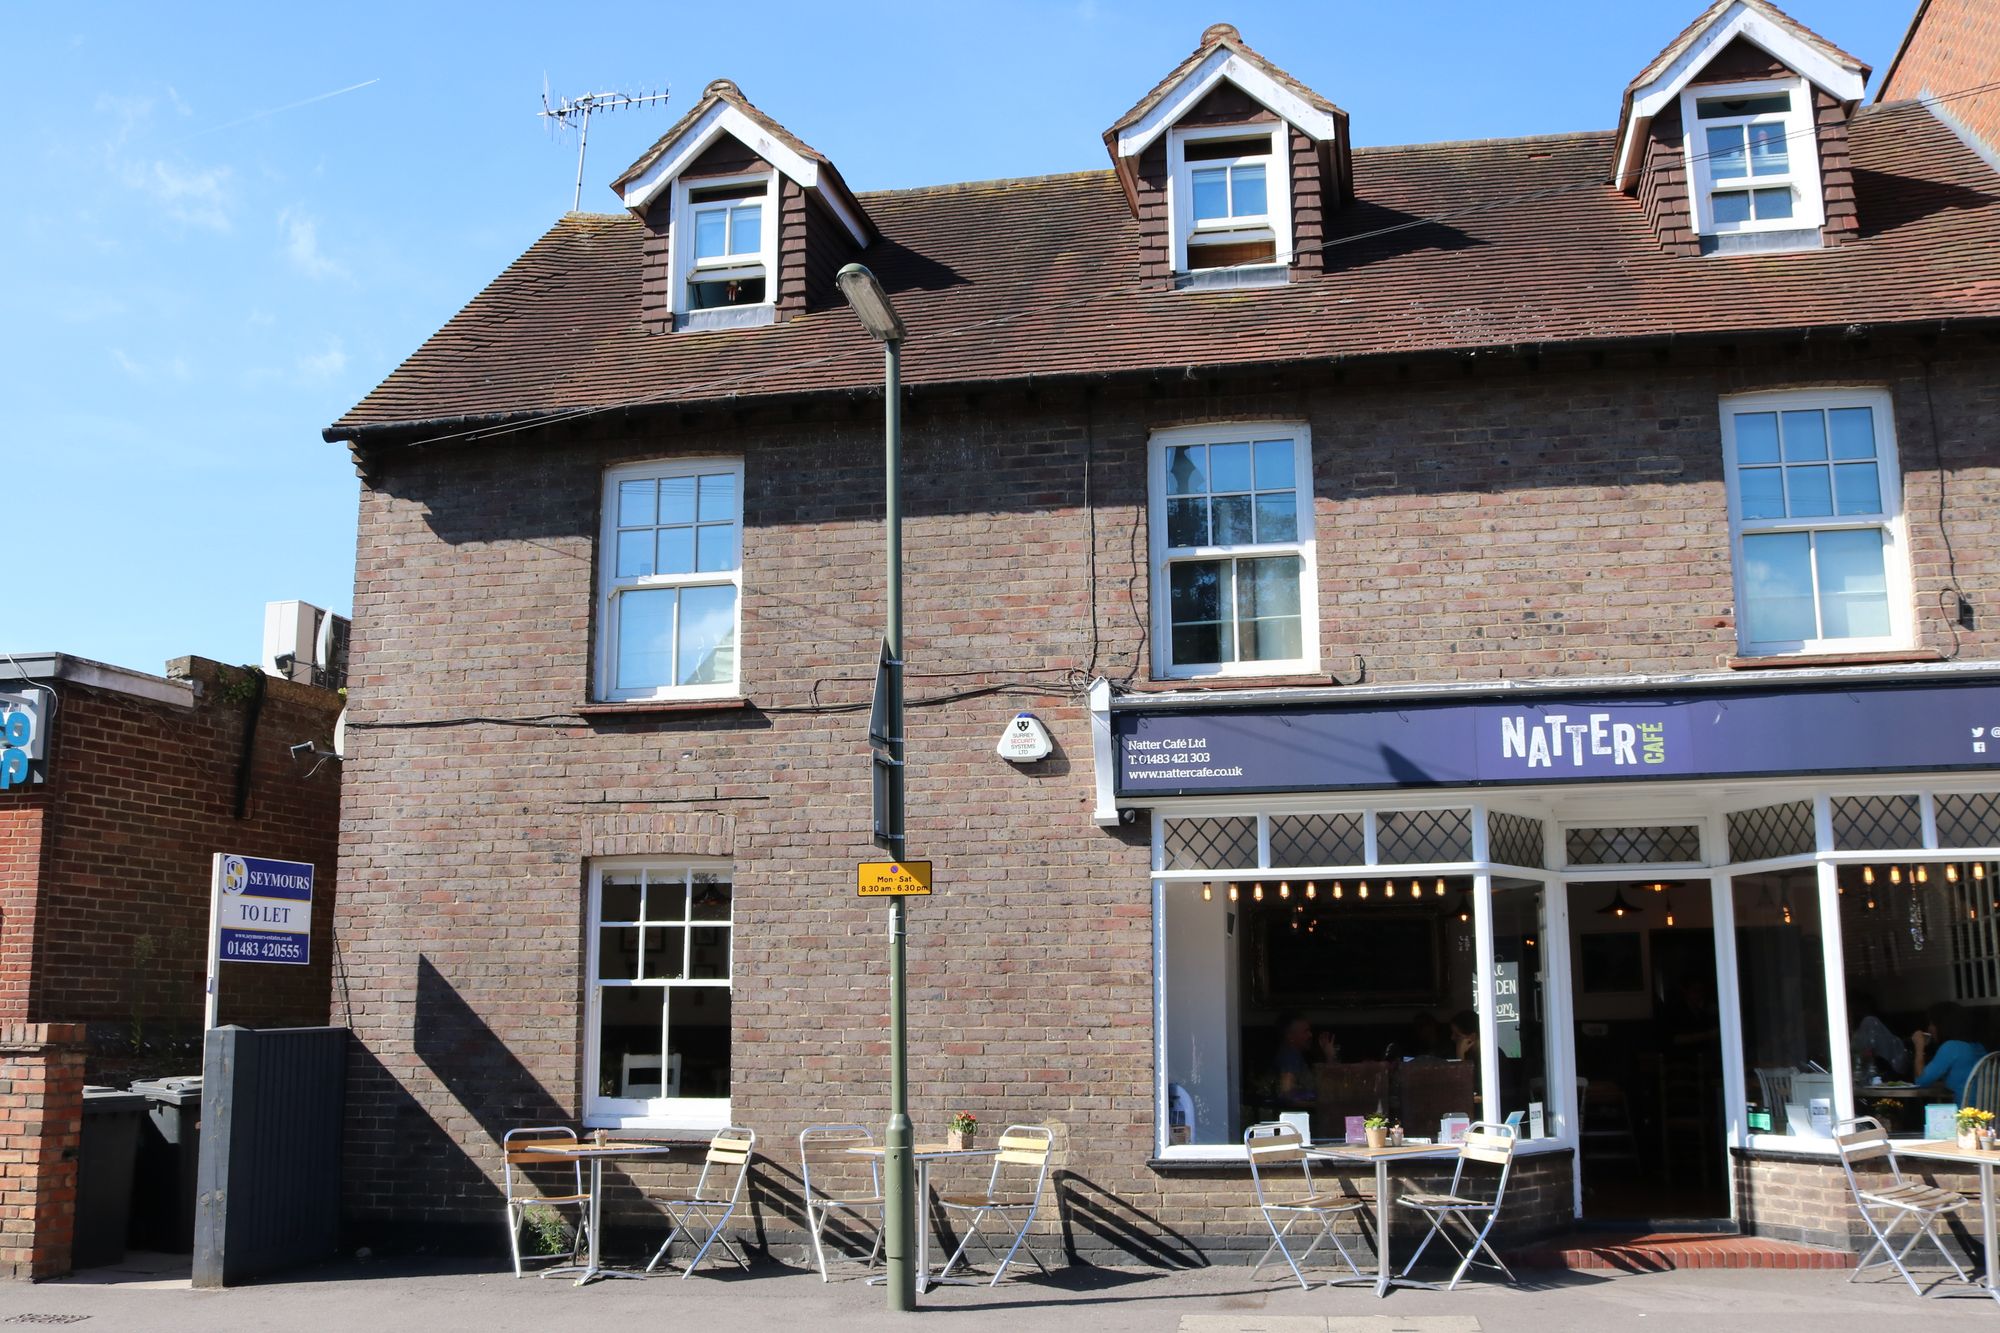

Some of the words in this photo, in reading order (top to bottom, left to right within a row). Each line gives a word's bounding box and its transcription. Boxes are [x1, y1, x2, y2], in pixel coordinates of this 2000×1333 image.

[1128, 739, 1161, 750] Natter
[1162, 738, 1187, 749] Café
[1188, 738, 1206, 749] Ltd
[1502, 713, 1638, 768] NATTER
[1636, 722, 1665, 765] CAFÉ
[1128, 754, 1138, 765] T.
[1138, 753, 1170, 765] 01483
[1171, 753, 1189, 763] 421
[1190, 752, 1210, 763] 303
[1128, 766, 1243, 779] www.nattercafe.co.uk
[250, 871, 310, 890] SEYMOURS
[240, 904, 259, 921] TO
[263, 906, 291, 923] LET
[227, 940, 259, 956] 01483
[262, 942, 300, 958] 420555
